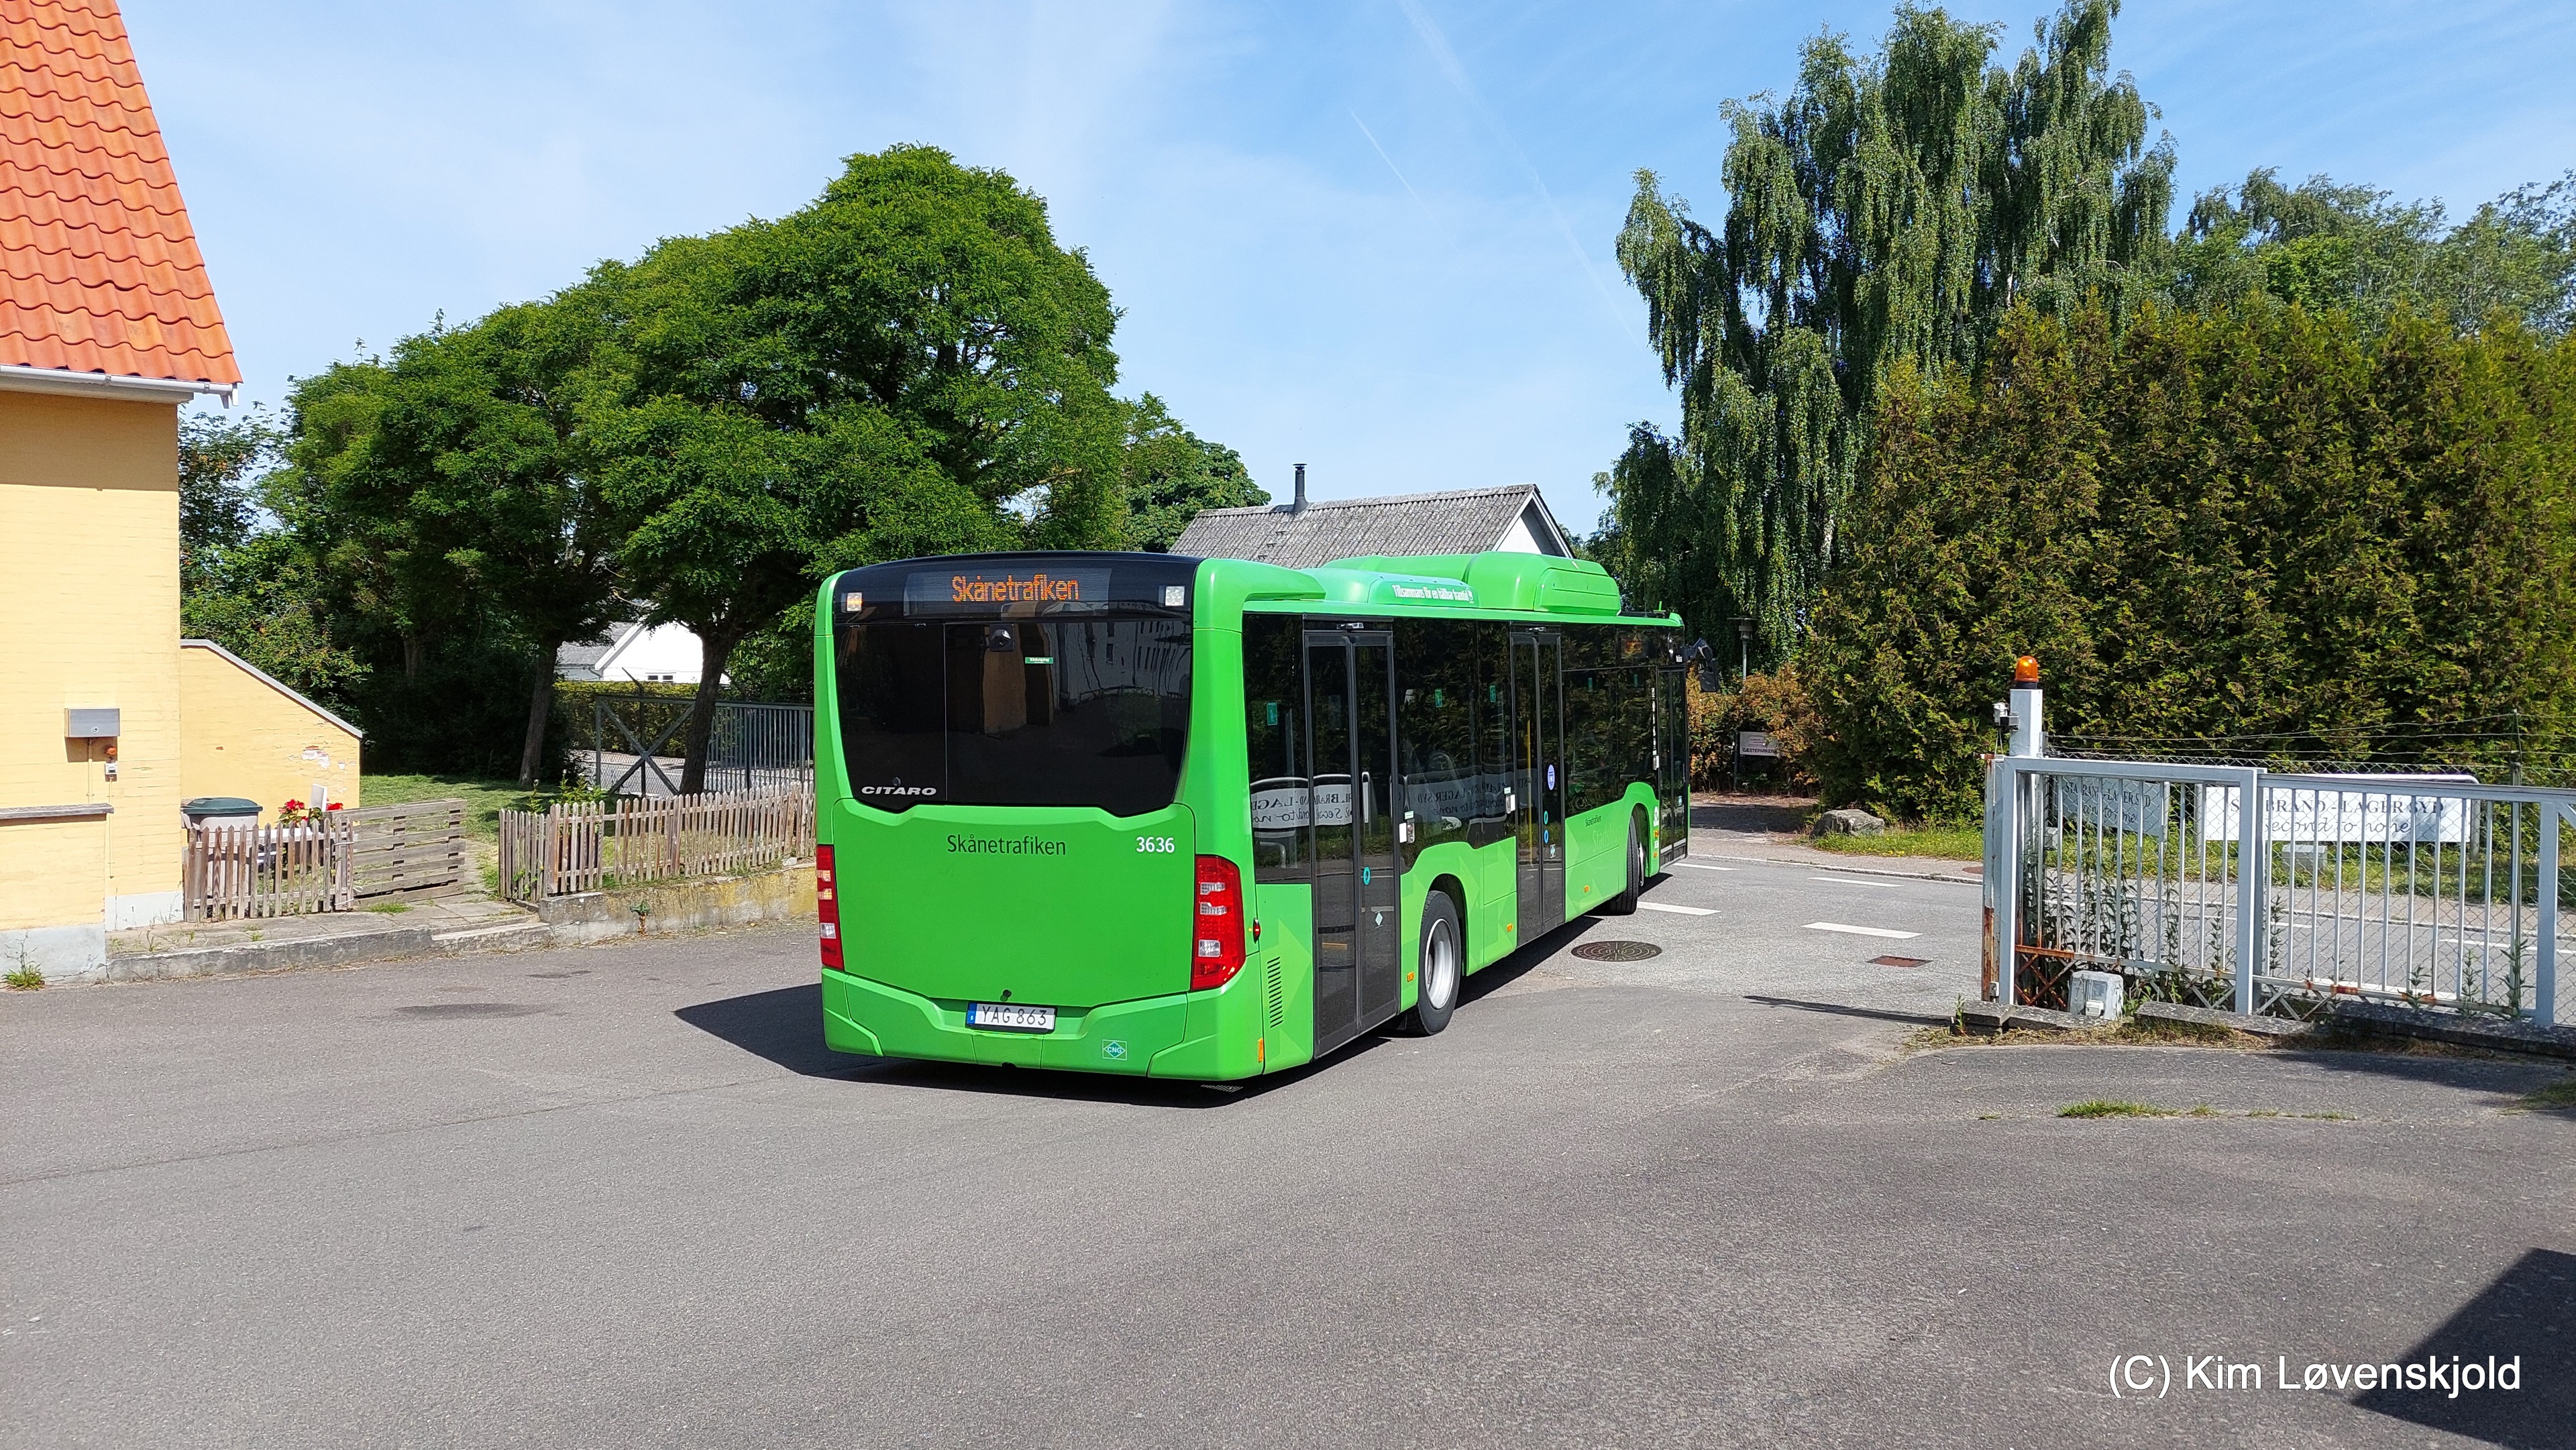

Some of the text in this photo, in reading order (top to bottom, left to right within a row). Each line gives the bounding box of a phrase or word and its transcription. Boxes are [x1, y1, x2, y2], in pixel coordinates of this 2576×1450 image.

[952, 574, 1079, 602] Skånetrafiken
[861, 787, 937, 795] CITARO
[2107, 789, 2134, 805] LAER
[2135, 793, 2151, 807] SD
[2343, 800, 2404, 814] LAGER
[947, 834, 1066, 856] Skånetrafiken
[1136, 836, 1175, 853] 3636
[982, 1005, 1047, 1025] YAG 863
